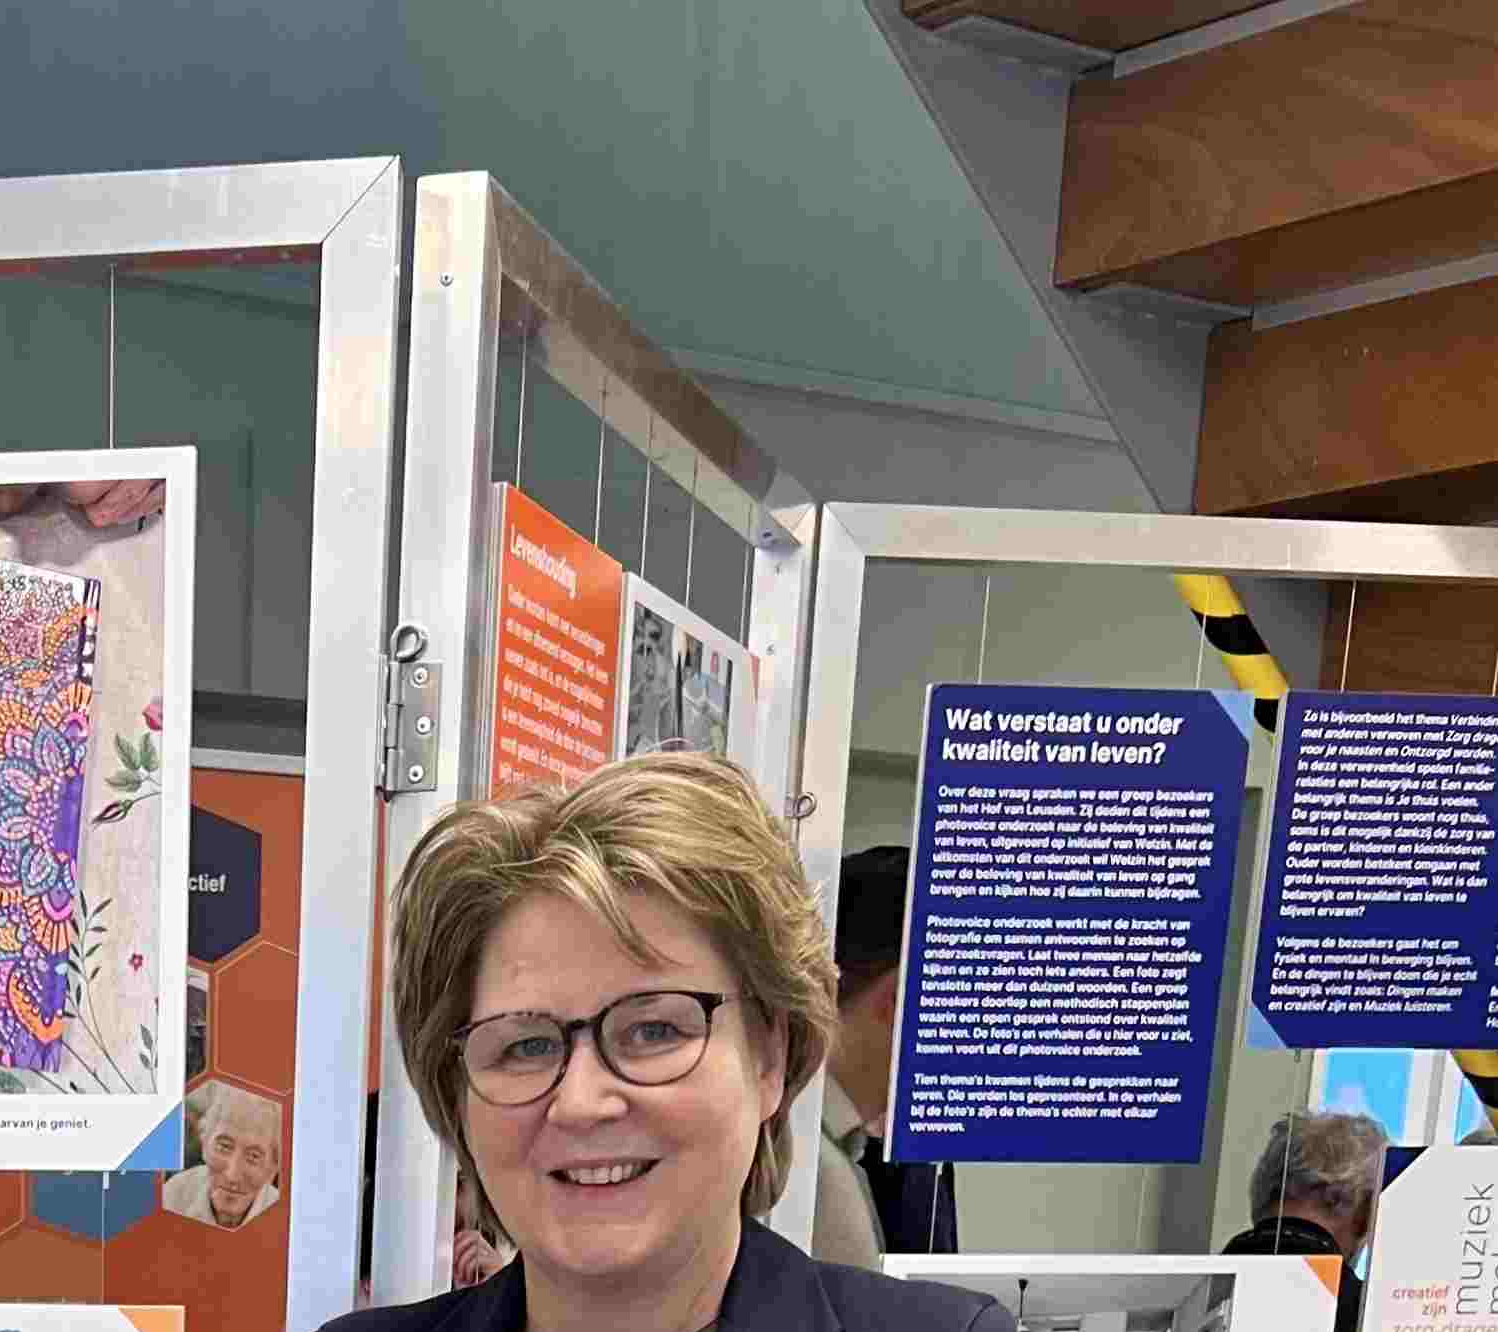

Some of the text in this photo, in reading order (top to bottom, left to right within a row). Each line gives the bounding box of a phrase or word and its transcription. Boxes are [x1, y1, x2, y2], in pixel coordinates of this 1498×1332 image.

[946, 708, 1183, 735] Wat verstaat u onder
[942, 738, 1166, 764] kwaliteit van leven?
[1079, 803, 1094, 818] Zij
[187, 873, 226, 892] ctief
[36, 1118, 47, 1130] je
[1454, 1183, 1495, 1315] muziek
[1392, 1286, 1449, 1300] creatief
[1421, 1303, 1448, 1318] zijn
